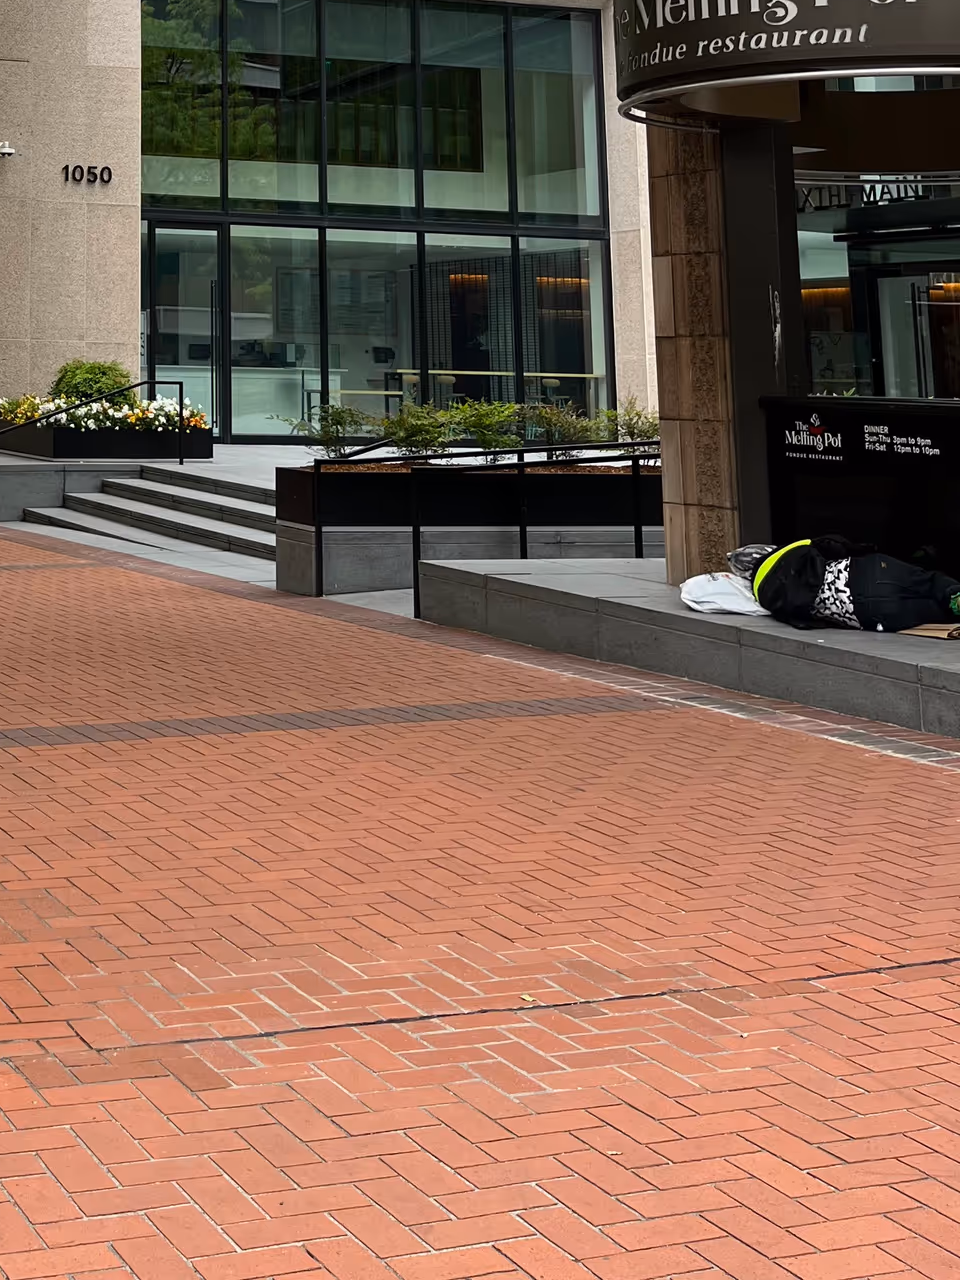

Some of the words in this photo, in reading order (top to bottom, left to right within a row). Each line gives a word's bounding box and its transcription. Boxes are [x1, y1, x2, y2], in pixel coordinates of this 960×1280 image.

[696, 23, 869, 57] restaurant
[61, 164, 113, 184] 1050
[861, 184, 919, 202] MAIN
[795, 421, 809, 431] The
[864, 425, 889, 434] DINNER
[785, 430, 823, 451] Melting
[824, 432, 842, 448] Pot
[864, 433, 891, 443] Sun-Thu
[908, 437, 916, 445] to
[916, 437, 932, 447] 9pm
[865, 442, 887, 451] Fri-Sat
[893, 444, 912, 454] 12pm
[912, 446, 920, 454] to
[922, 446, 940, 456] 10pm
